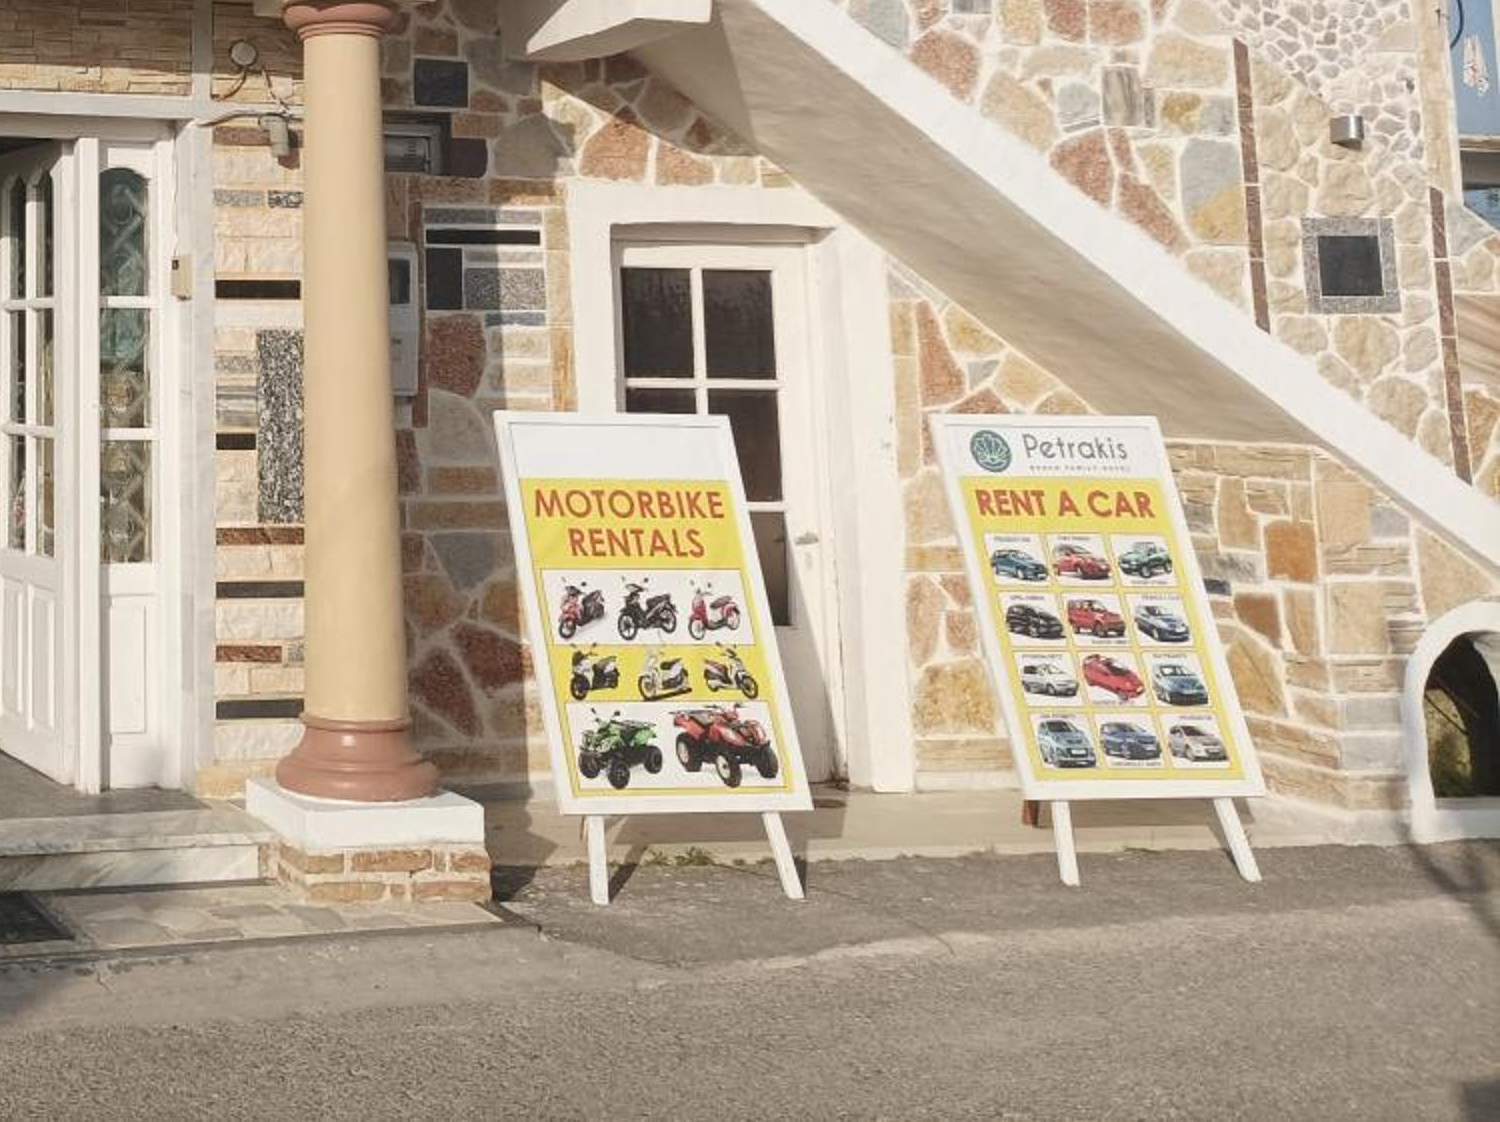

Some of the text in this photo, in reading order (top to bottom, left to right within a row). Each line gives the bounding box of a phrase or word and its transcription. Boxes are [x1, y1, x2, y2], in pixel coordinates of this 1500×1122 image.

[1023, 434, 1128, 460] Petrakis
[535, 489, 724, 518] MOTORBIKE
[975, 489, 1155, 519] RENT A CAR
[568, 528, 705, 558] RENTALS
